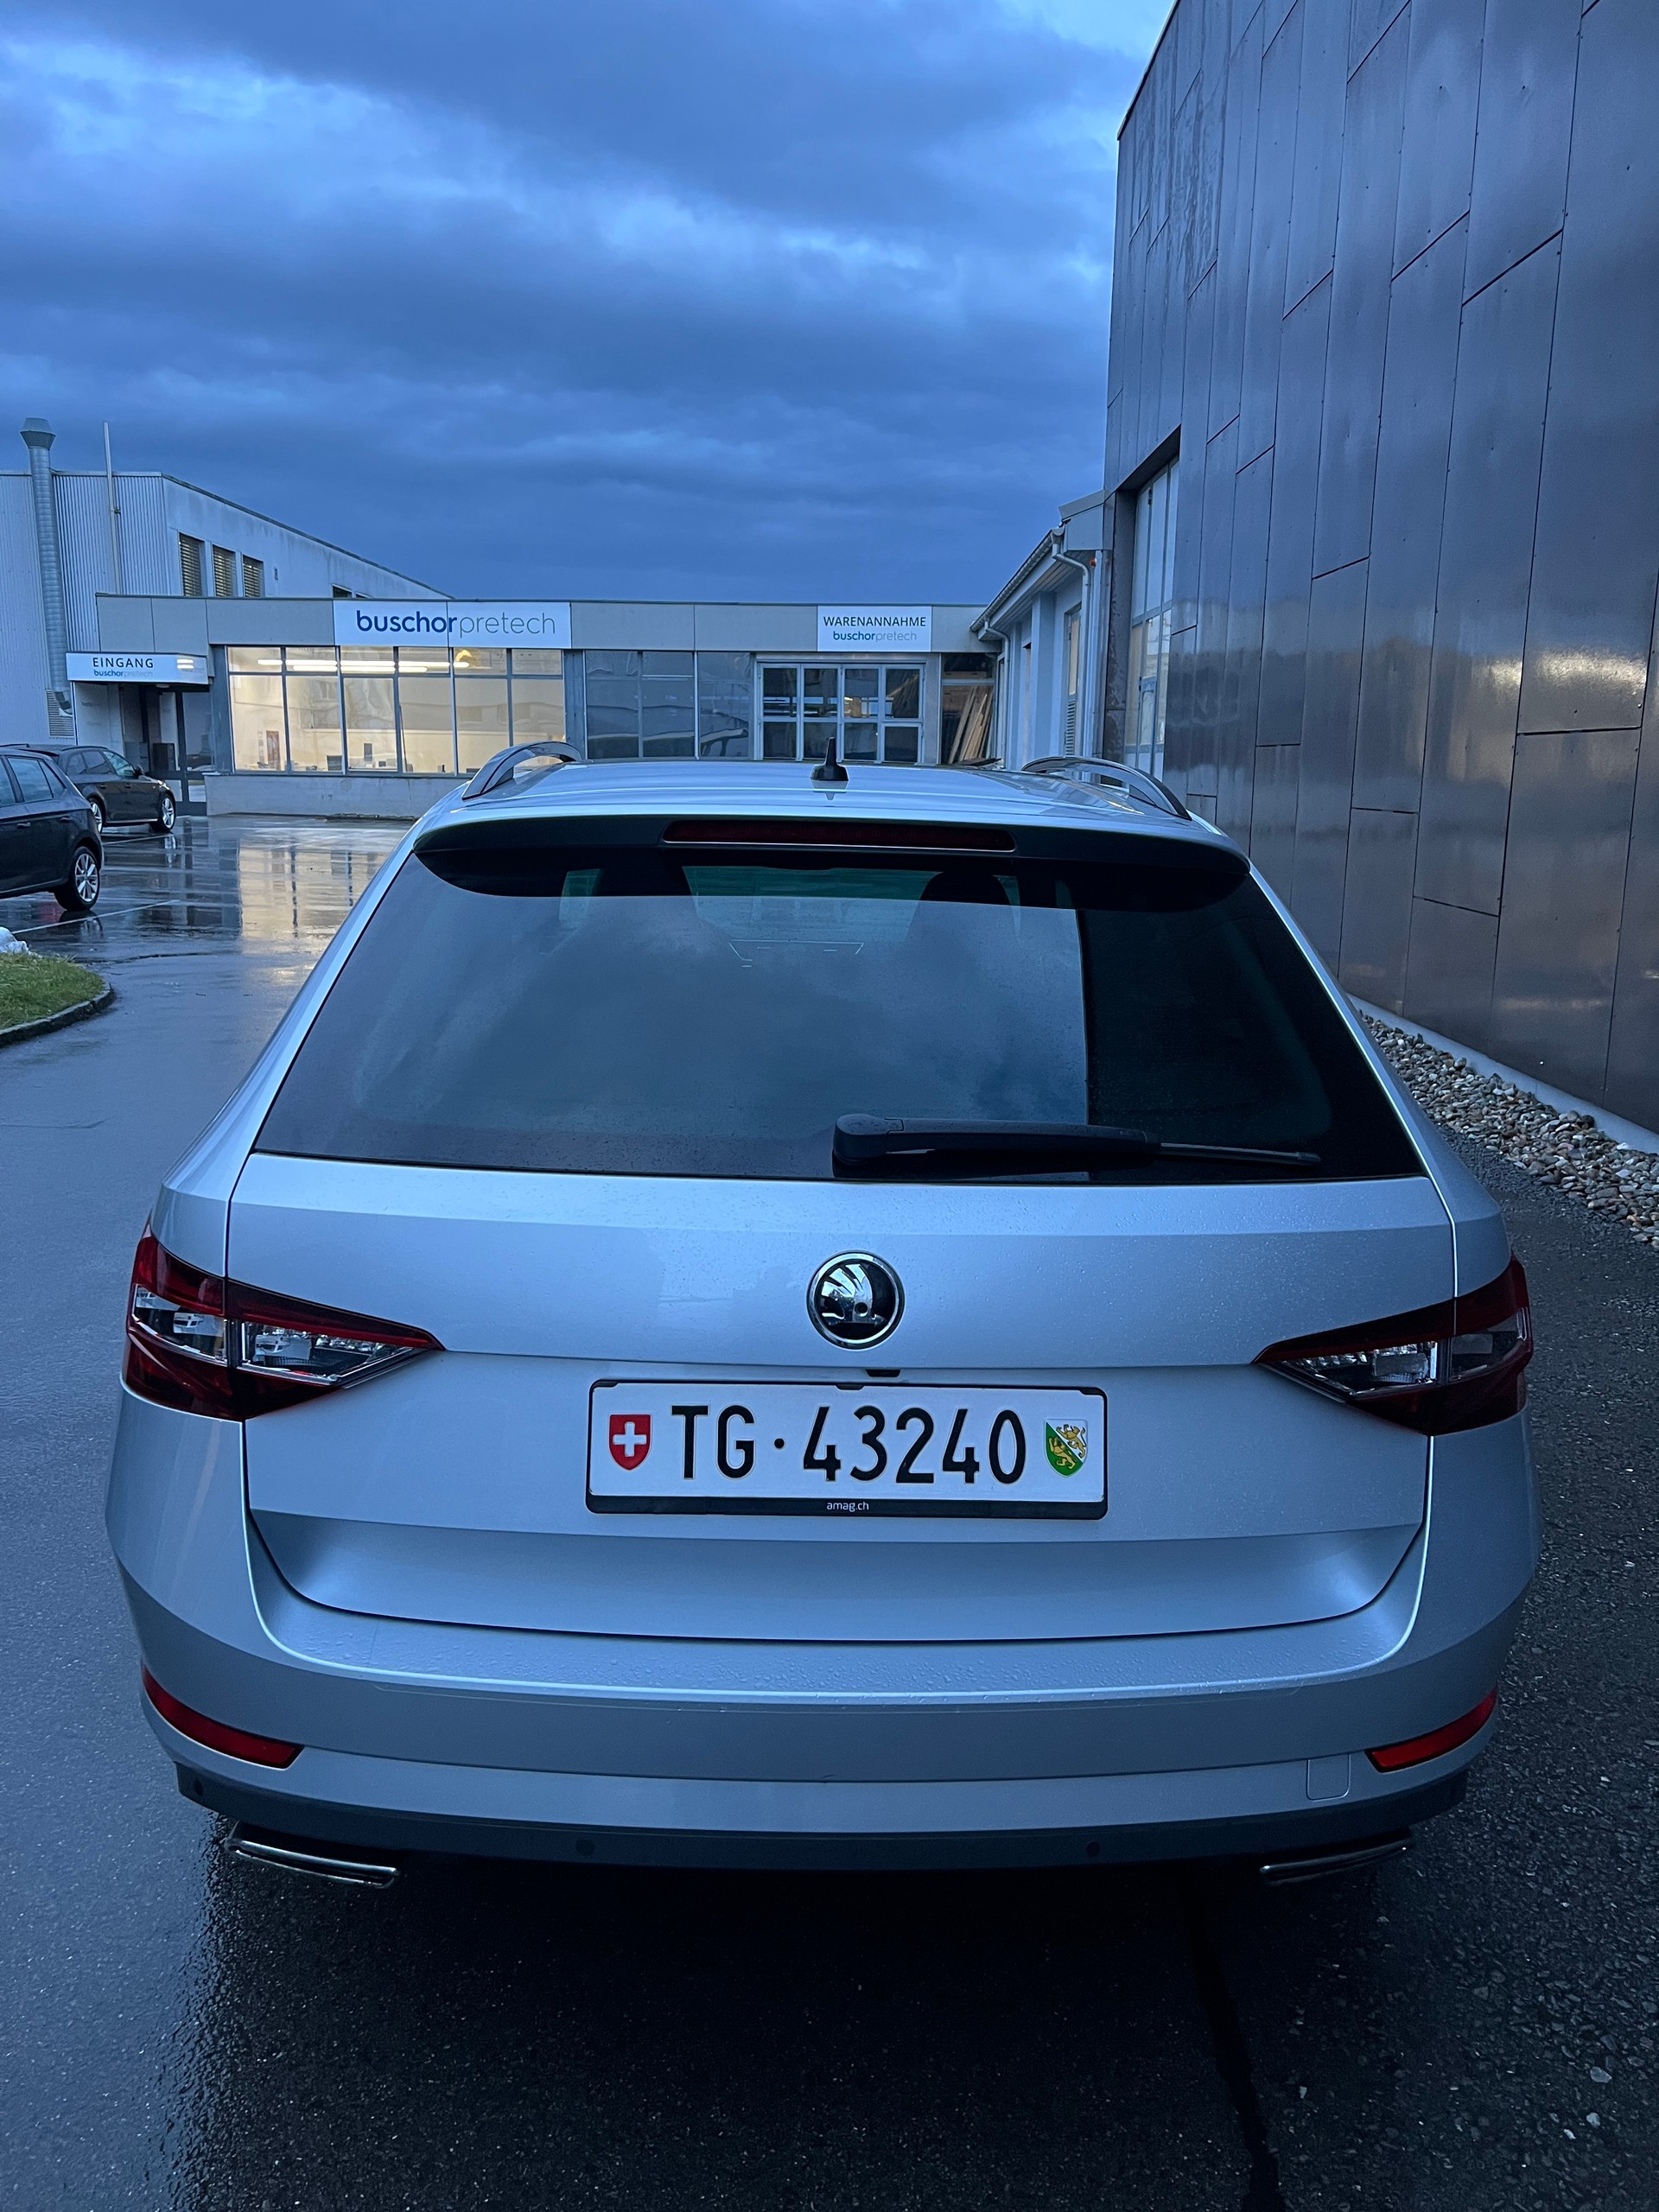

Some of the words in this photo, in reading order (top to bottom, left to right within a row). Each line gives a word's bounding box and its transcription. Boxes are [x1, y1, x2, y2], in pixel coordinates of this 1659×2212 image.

[356, 610, 556, 638] buschorpretech
[823, 616, 926, 626] WARENANNAHME
[833, 631, 917, 642] buschorpretech
[92, 658, 154, 668] EINGANG
[826, 1501, 869, 1512] amag.ch
